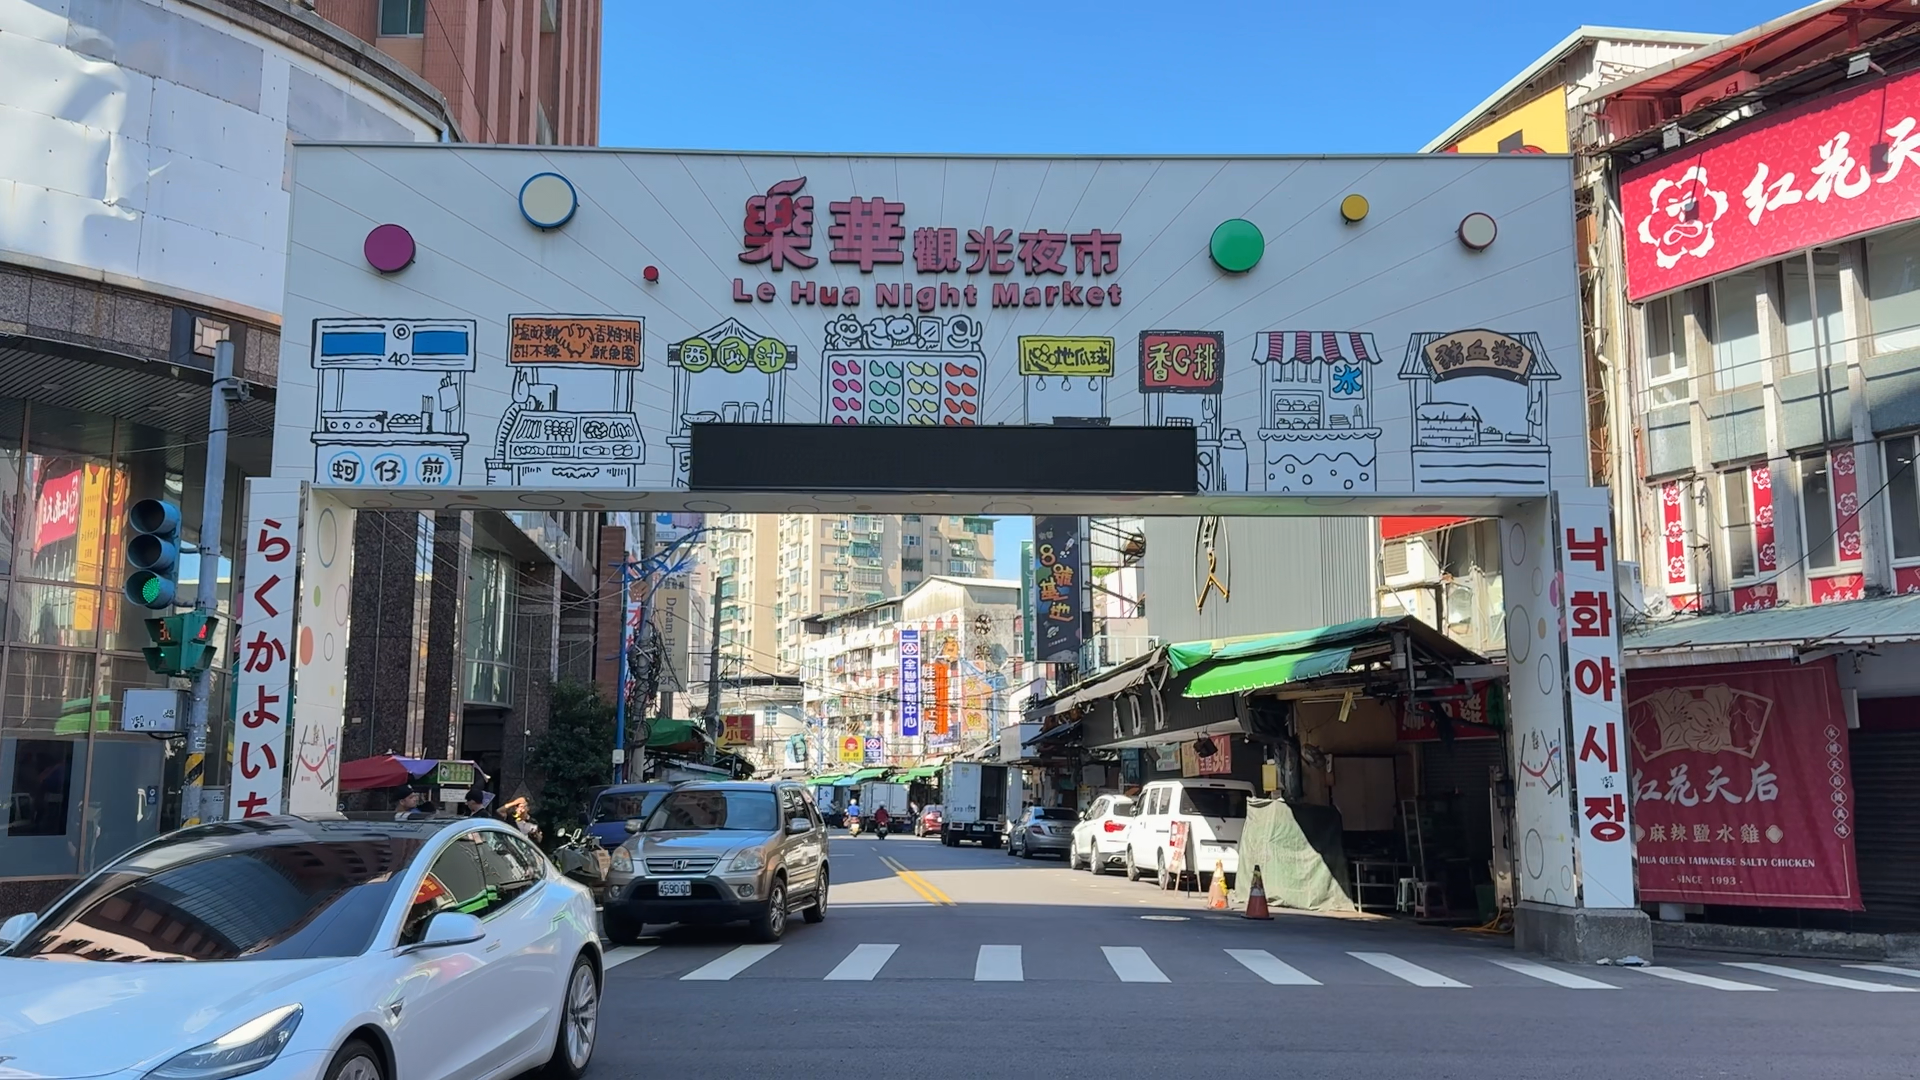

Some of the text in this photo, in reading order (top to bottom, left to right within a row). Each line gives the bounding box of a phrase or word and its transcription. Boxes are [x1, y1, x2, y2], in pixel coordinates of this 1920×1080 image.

[733, 278, 1122, 312] Le Hua Night Market
[388, 352, 410, 366] 40
[684, 342, 784, 367] 西瓜汁
[1147, 342, 1216, 381] 香G排
[332, 456, 444, 483] 蚵仔煎
[665, 597, 677, 634] Dream
[237, 518, 290, 818] らくかよいち
[1566, 527, 1626, 843] 낙화야시장
[1640, 855, 1815, 867] HUA QUEEN TAIWANESE SALTY CHICKEN
[1710, 876, 1737, 885] 1993
